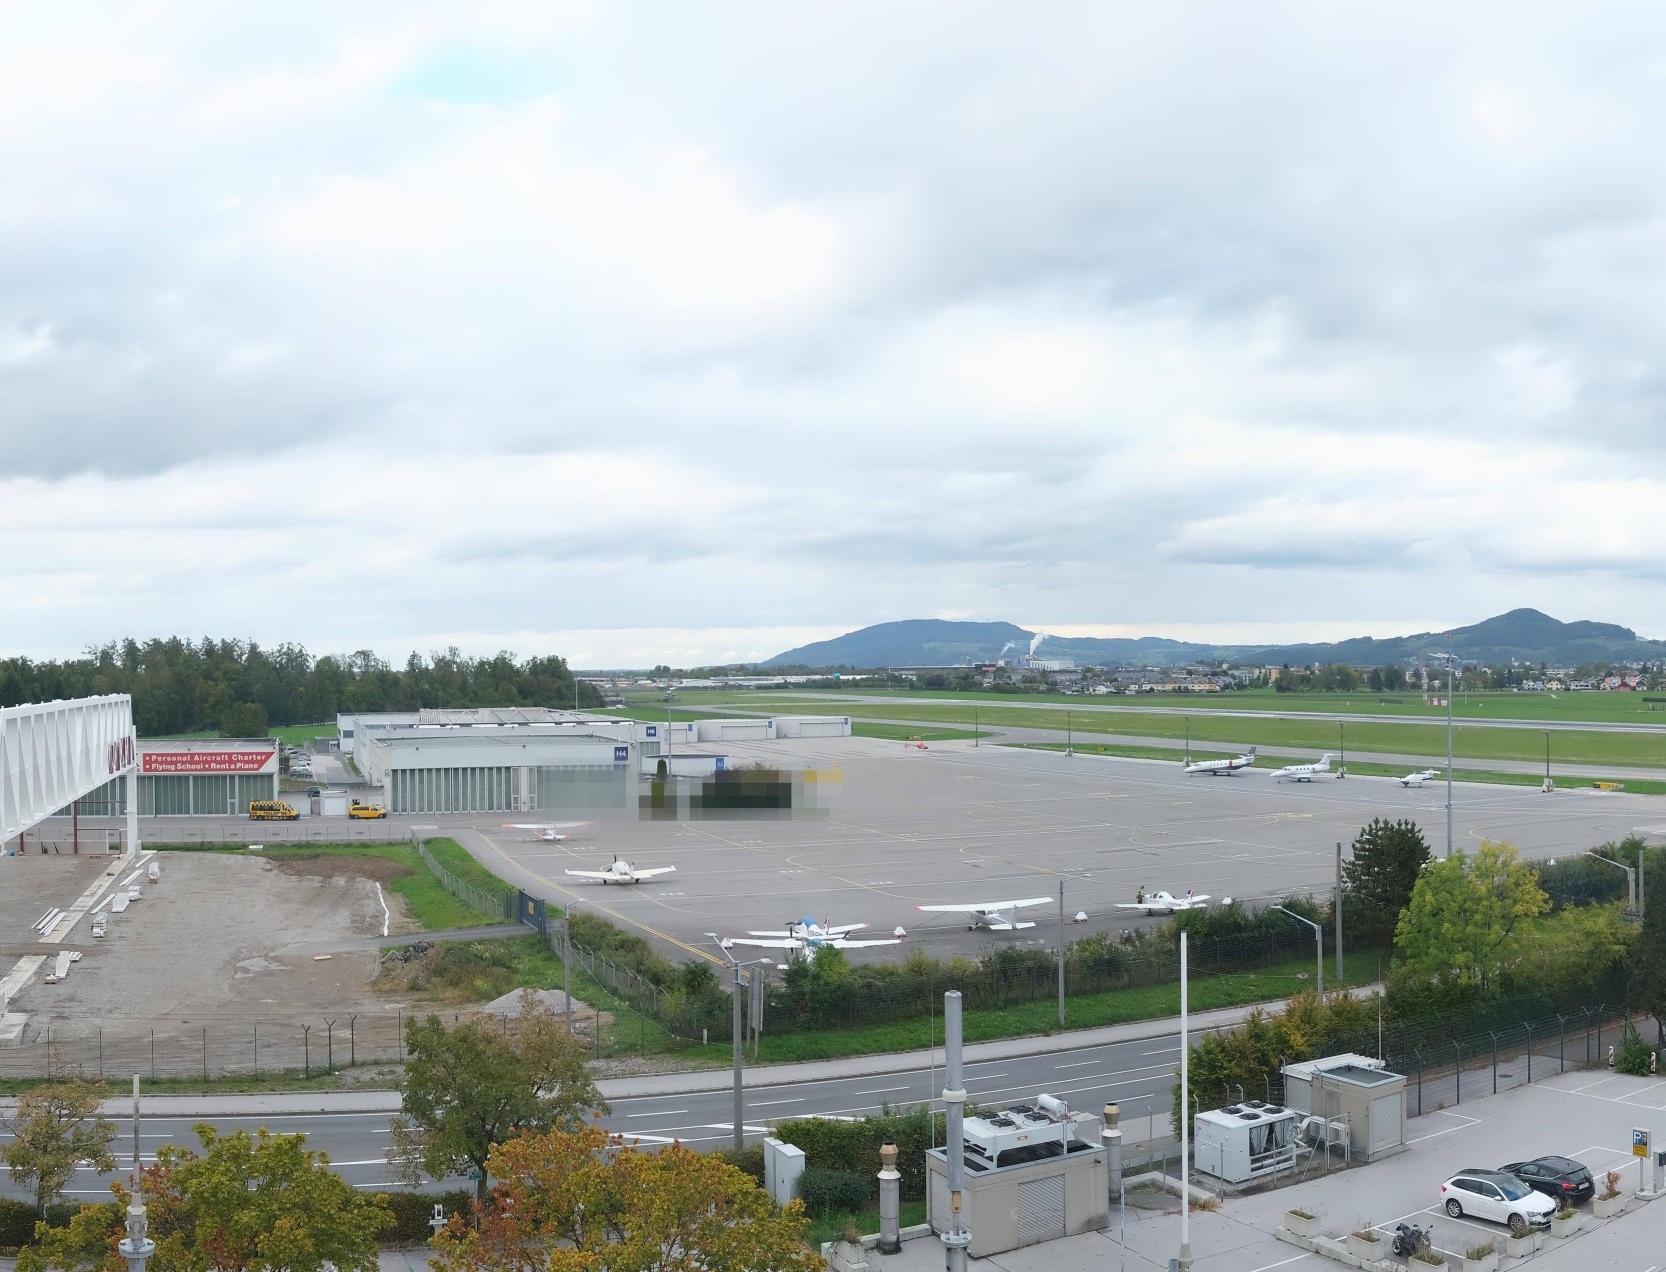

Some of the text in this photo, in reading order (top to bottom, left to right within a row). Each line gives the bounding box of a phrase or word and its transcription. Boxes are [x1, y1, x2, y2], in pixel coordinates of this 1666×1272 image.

[151, 753, 266, 762] Personal Aircraft Charter
[151, 763, 175, 771] Flying
[210, 762, 229, 770] Rent
[1633, 1131, 1642, 1144] P
